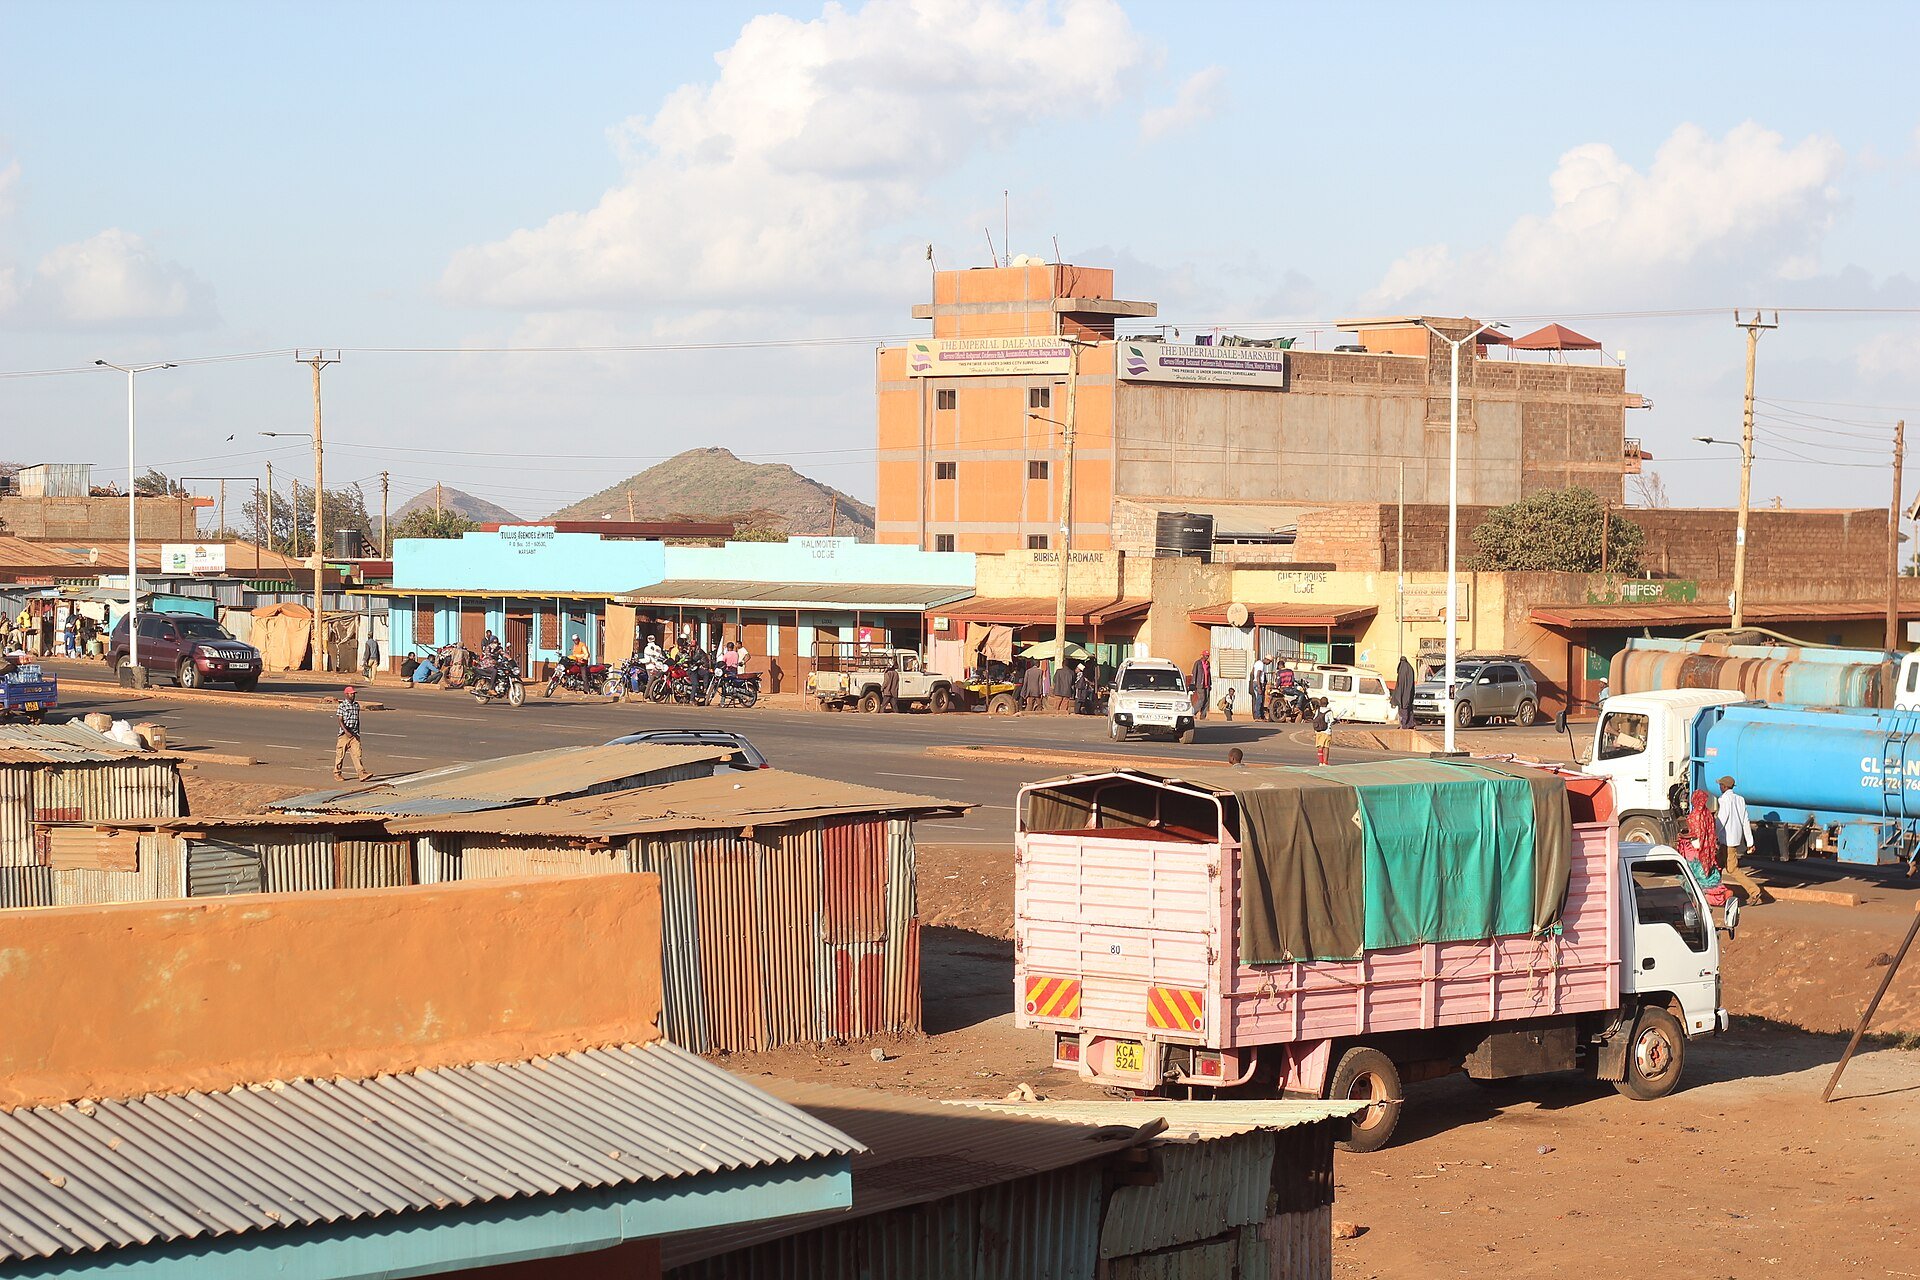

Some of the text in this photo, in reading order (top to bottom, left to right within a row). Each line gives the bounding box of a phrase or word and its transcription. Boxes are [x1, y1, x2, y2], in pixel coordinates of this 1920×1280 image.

[940, 341, 957, 350] THE
[959, 340, 999, 350] IMPERIAL
[1160, 346, 1177, 355] THE
[1180, 346, 1216, 358] IMPERIAL
[812, 550, 835, 559] LODGE
[1034, 553, 1103, 562] BUBISA ARDWARE
[1116, 1045, 1134, 1057] KCA
[1116, 1057, 1139, 1070] 524L
